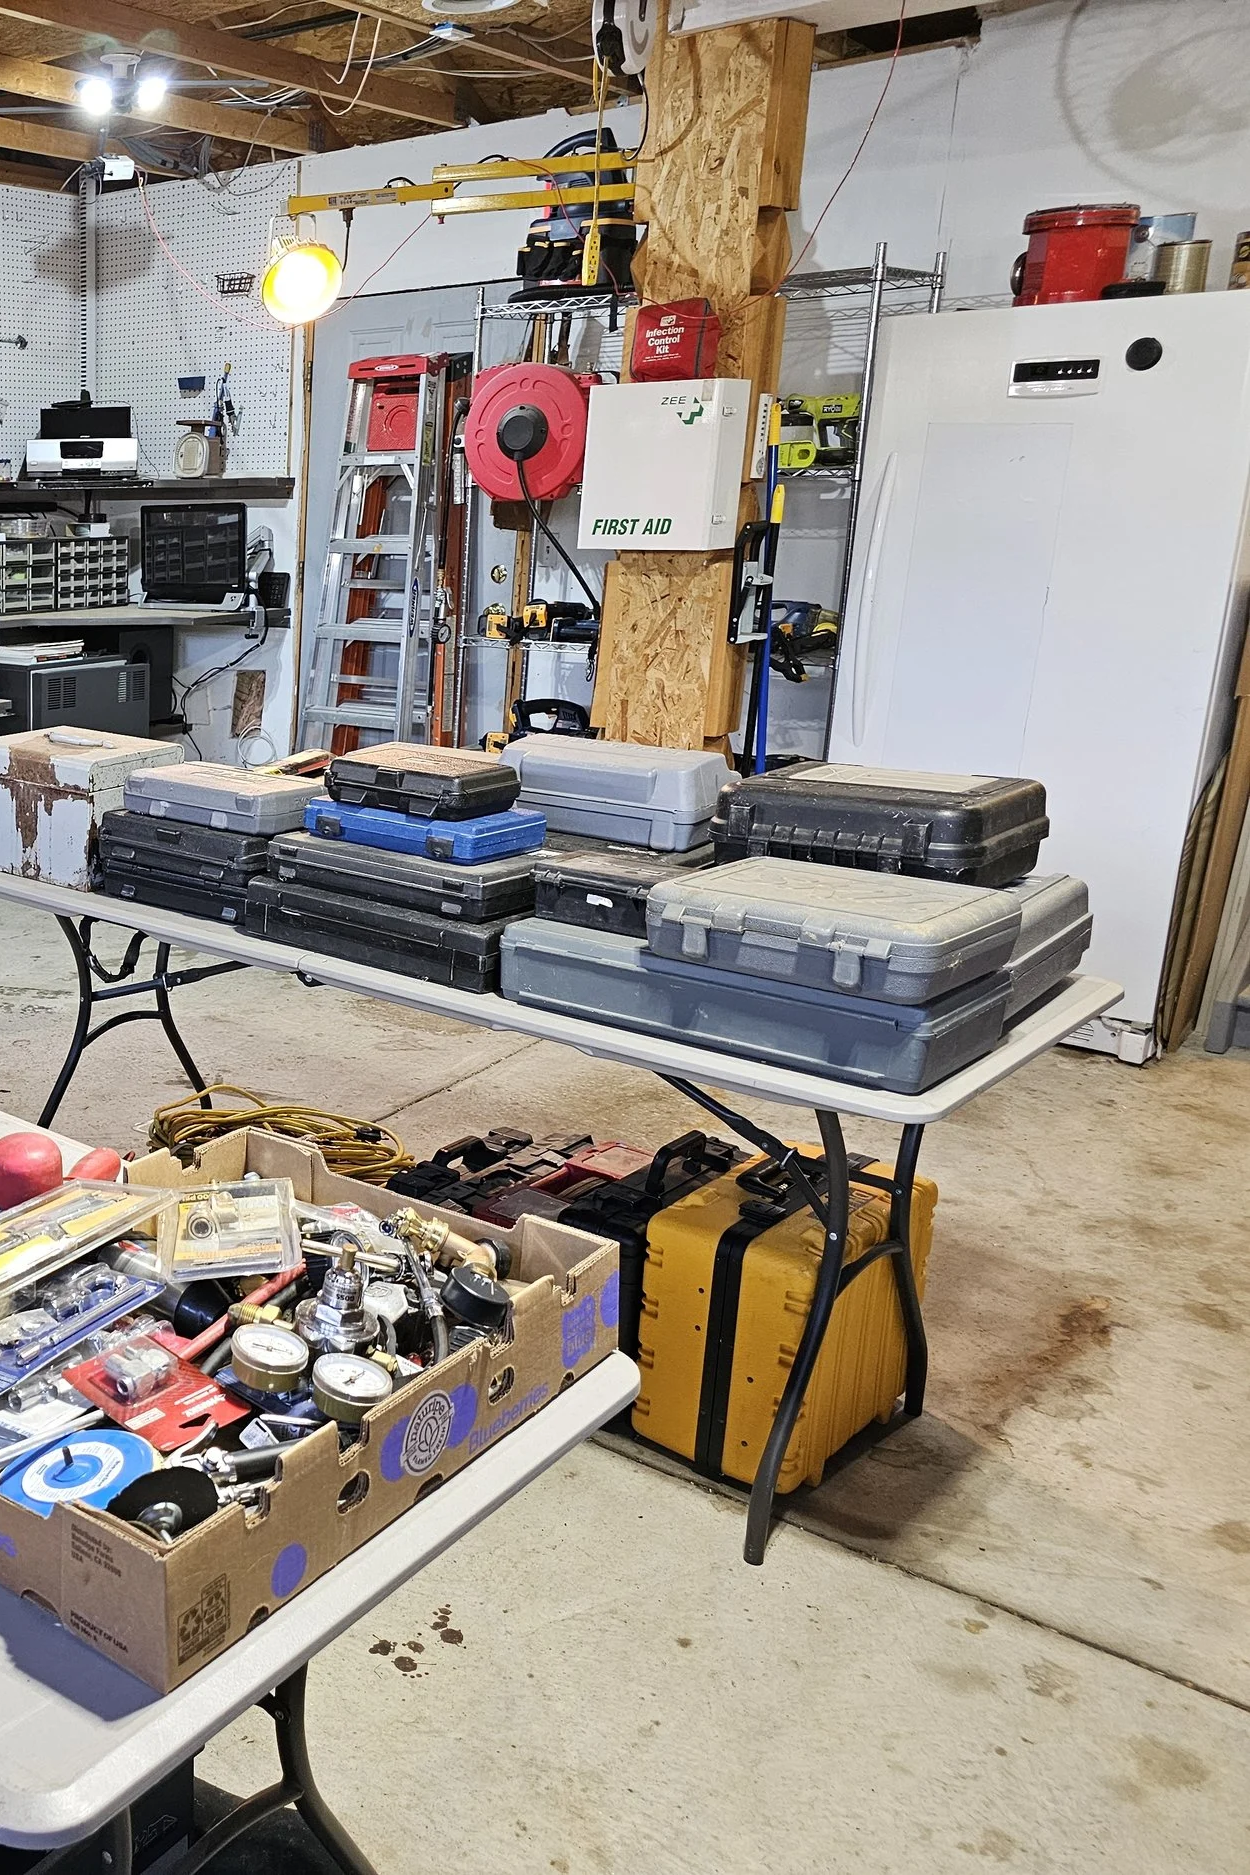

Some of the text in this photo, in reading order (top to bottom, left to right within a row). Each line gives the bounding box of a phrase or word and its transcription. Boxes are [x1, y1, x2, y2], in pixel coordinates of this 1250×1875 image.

[645, 326, 685, 338] Infection
[648, 334, 680, 346] Control
[656, 345, 670, 354] Kit
[661, 396, 687, 405] ZEE
[592, 518, 672, 535] FIRST AID
[336, 1291, 357, 1303] GOSS
[410, 1398, 445, 1442] naturipe
[469, 1382, 549, 1455] Blueberries
[71, 1551, 83, 1563] USA
[70, 1610, 103, 1636] PRODUCT
[113, 1639, 128, 1653] USA
